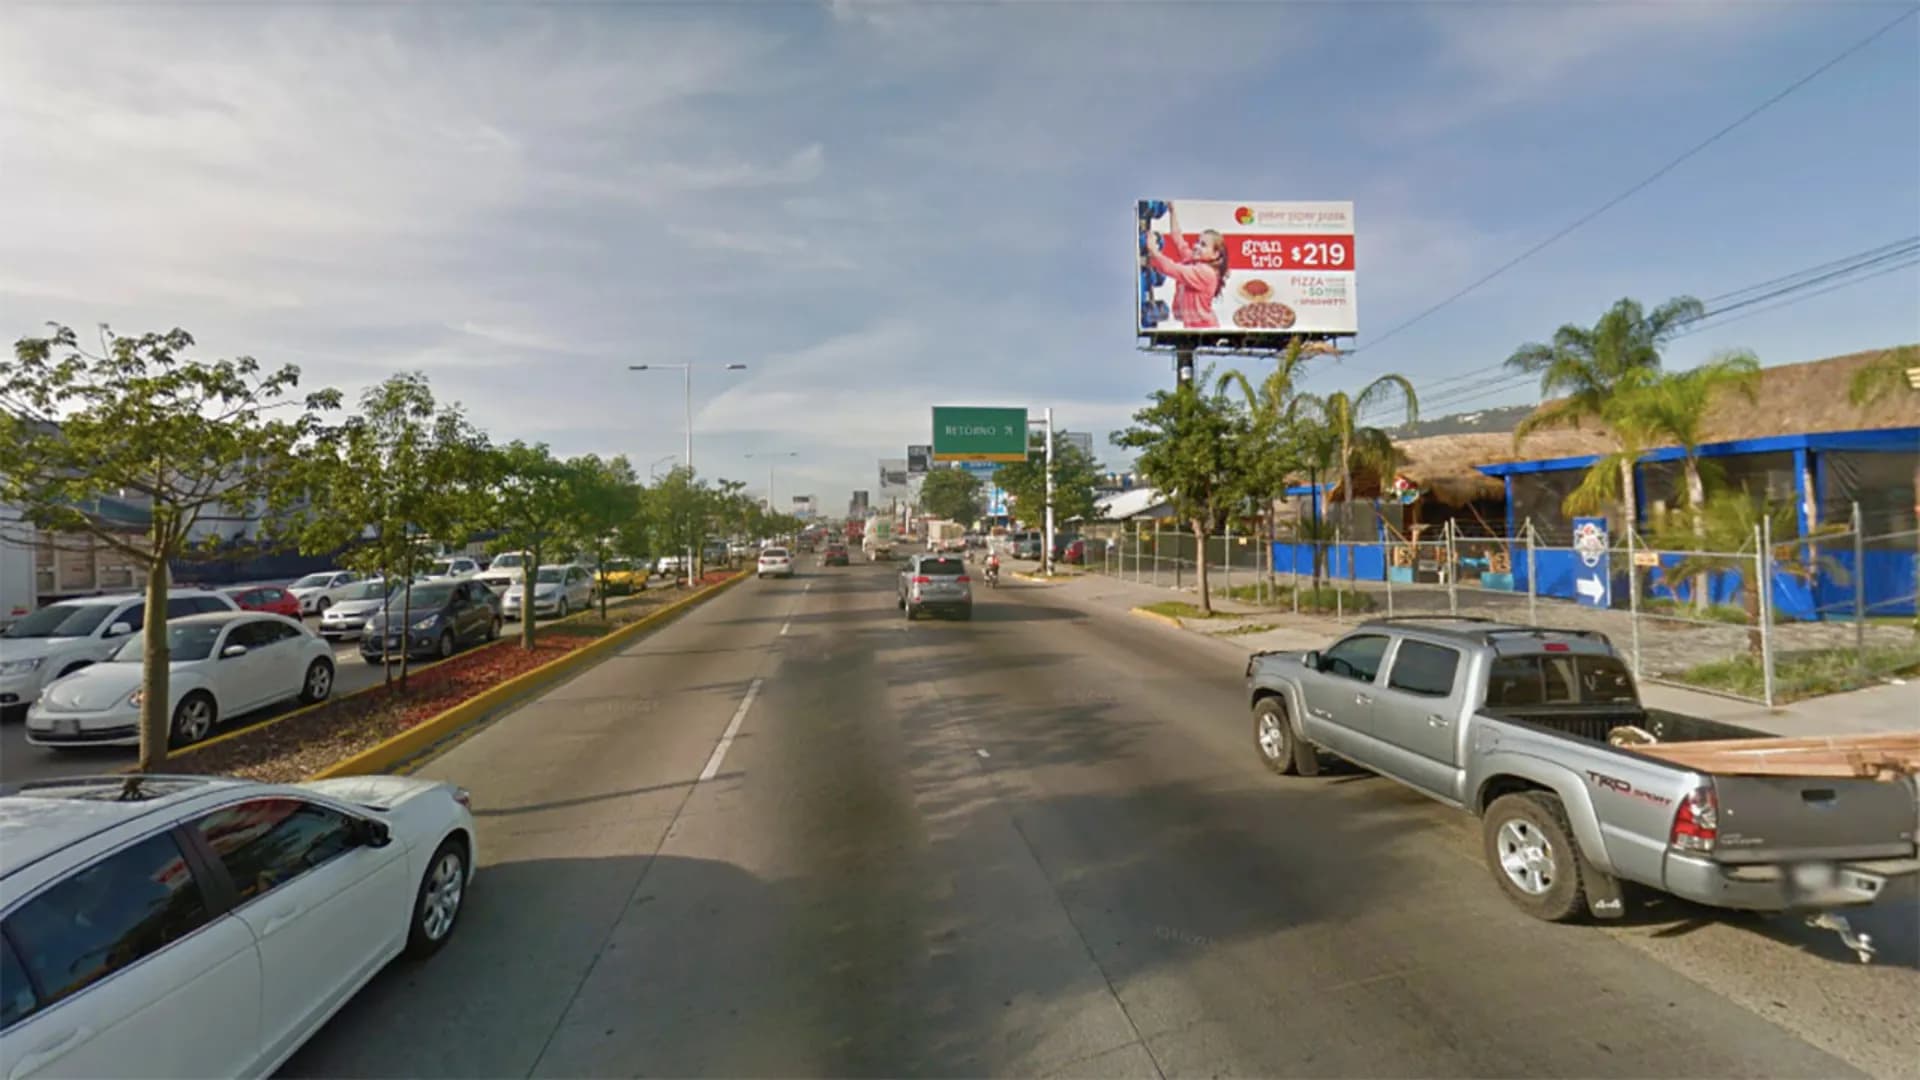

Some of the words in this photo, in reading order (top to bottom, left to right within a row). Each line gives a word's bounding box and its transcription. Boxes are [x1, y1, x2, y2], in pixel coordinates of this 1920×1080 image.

[1242, 240, 1283, 256] gran
[1291, 243, 1345, 265] $219
[1251, 255, 1283, 267] trio
[1291, 276, 1323, 286] PIZZA
[945, 425, 996, 436] RETORNO
[1586, 769, 1632, 792] TRD
[1634, 789, 1672, 804] SPORT
